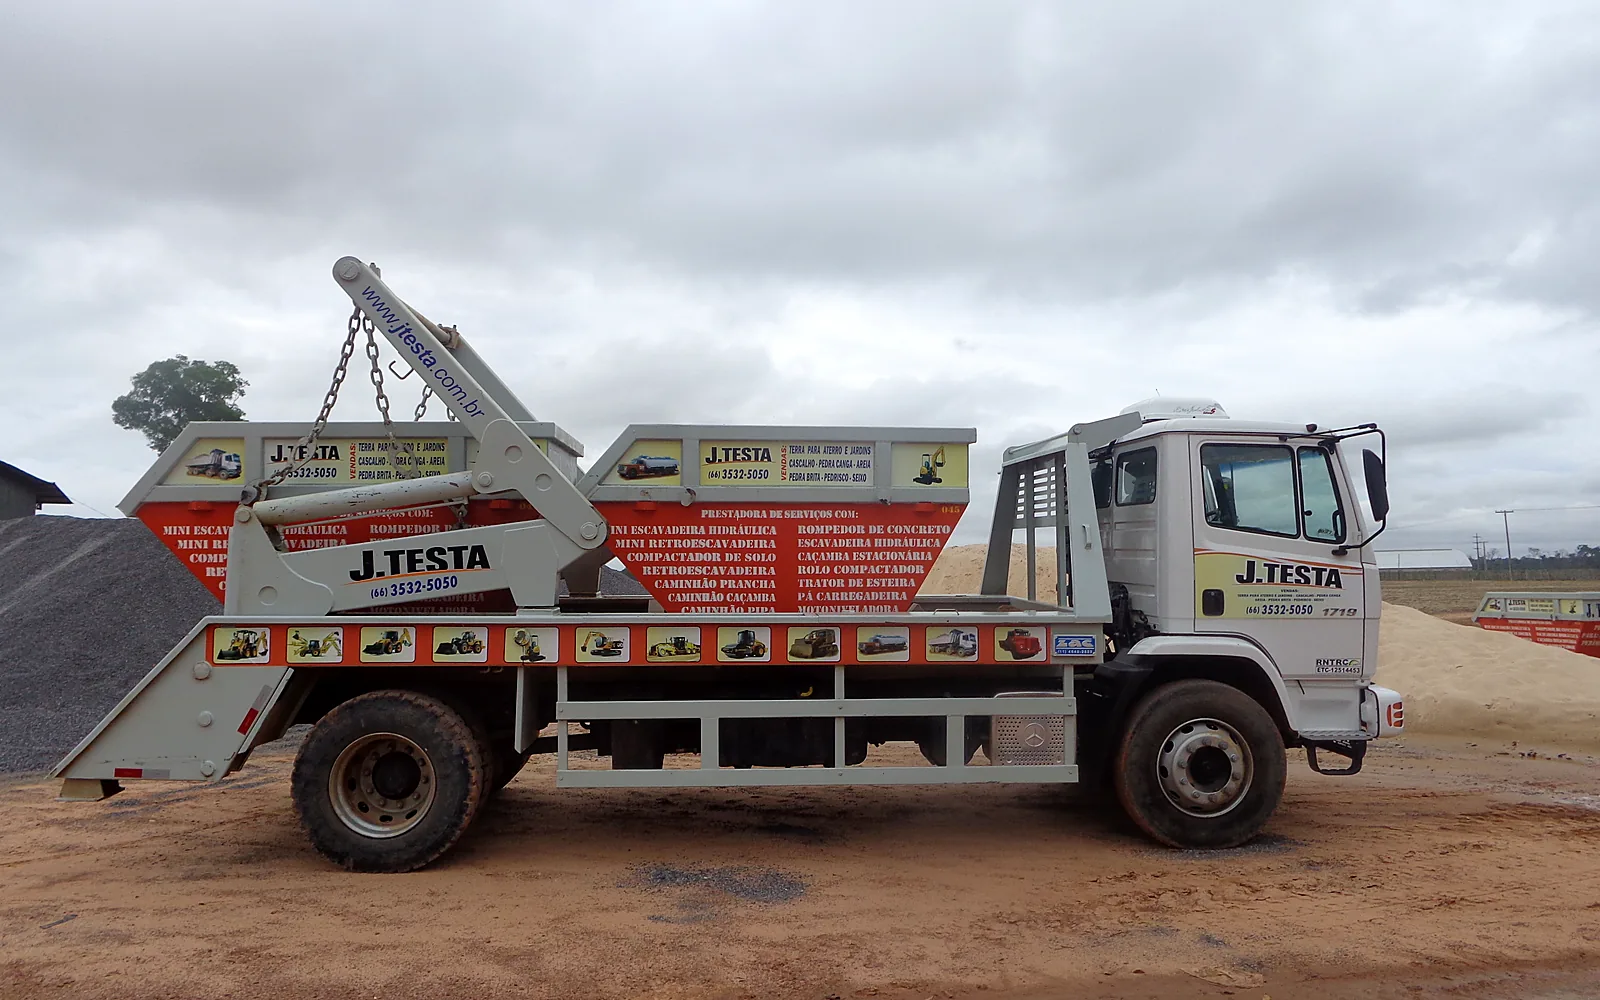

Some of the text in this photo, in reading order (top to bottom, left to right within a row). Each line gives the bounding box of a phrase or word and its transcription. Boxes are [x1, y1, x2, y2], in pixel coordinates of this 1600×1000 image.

[362, 286, 485, 418] www.jtesta.com.br
[358, 442, 376, 452] TERRA
[422, 443, 446, 452] JARDINS
[789, 446, 872, 455] TERRA PARA ATERRO E JARDINS
[705, 446, 772, 464] J.TESTA
[350, 442, 358, 480] VENDAS:
[358, 456, 386, 466] CASCALHO
[429, 456, 446, 466] AREIA
[789, 460, 816, 468] CASCALHO
[818, 460, 836, 468] PEDRA
[836, 460, 852, 468] CANGA
[856, 460, 871, 468] AREIA
[358, 470, 376, 480] PEDRA
[377, 470, 392, 480] BRITA
[708, 469, 768, 480] (66) 3532-5050
[789, 472, 806, 482] PEDRA
[807, 473, 820, 482] BRITA
[824, 473, 848, 482] PEDRISCO
[852, 474, 866, 482] SEIXO
[408, 509, 434, 518] COM:
[702, 510, 859, 520] PRESTADORA DE SERVIÇOS COM:
[164, 526, 190, 535] MINI
[370, 524, 440, 534] ROMPEDOR
[609, 524, 777, 534] INI ESCAVADEIRA HIDRÁULICA
[798, 524, 950, 534] ROMPEDOR DE CONCRETO
[178, 540, 208, 549] MINI
[616, 539, 776, 548] MINI RETROESCAVADEIRA
[798, 537, 940, 548] ESCAVADEIRA HIDRÁULICA
[626, 552, 776, 562] COMPACTADOR DE SOLO
[798, 550, 932, 563] CAÇAMBA ESTACIONÁRIA
[350, 544, 491, 582] J.TESTA
[642, 566, 776, 576] RETROESCAVADEIRA
[798, 565, 924, 575] ROLO COMPACTADOR
[1236, 560, 1342, 588] J.TESTA
[370, 576, 458, 599] (66) 3532-5050
[654, 577, 776, 588] CAMINHÃO PRANCHA
[798, 578, 916, 588] TRATOR DE ESTEIRA
[668, 591, 776, 604] CAMINHÃO CAÇAMBA
[798, 590, 908, 600] PÁ CARREGADEIRA
[1246, 604, 1313, 615] (66) 3532-5050
[1322, 608, 1358, 616] 1719
